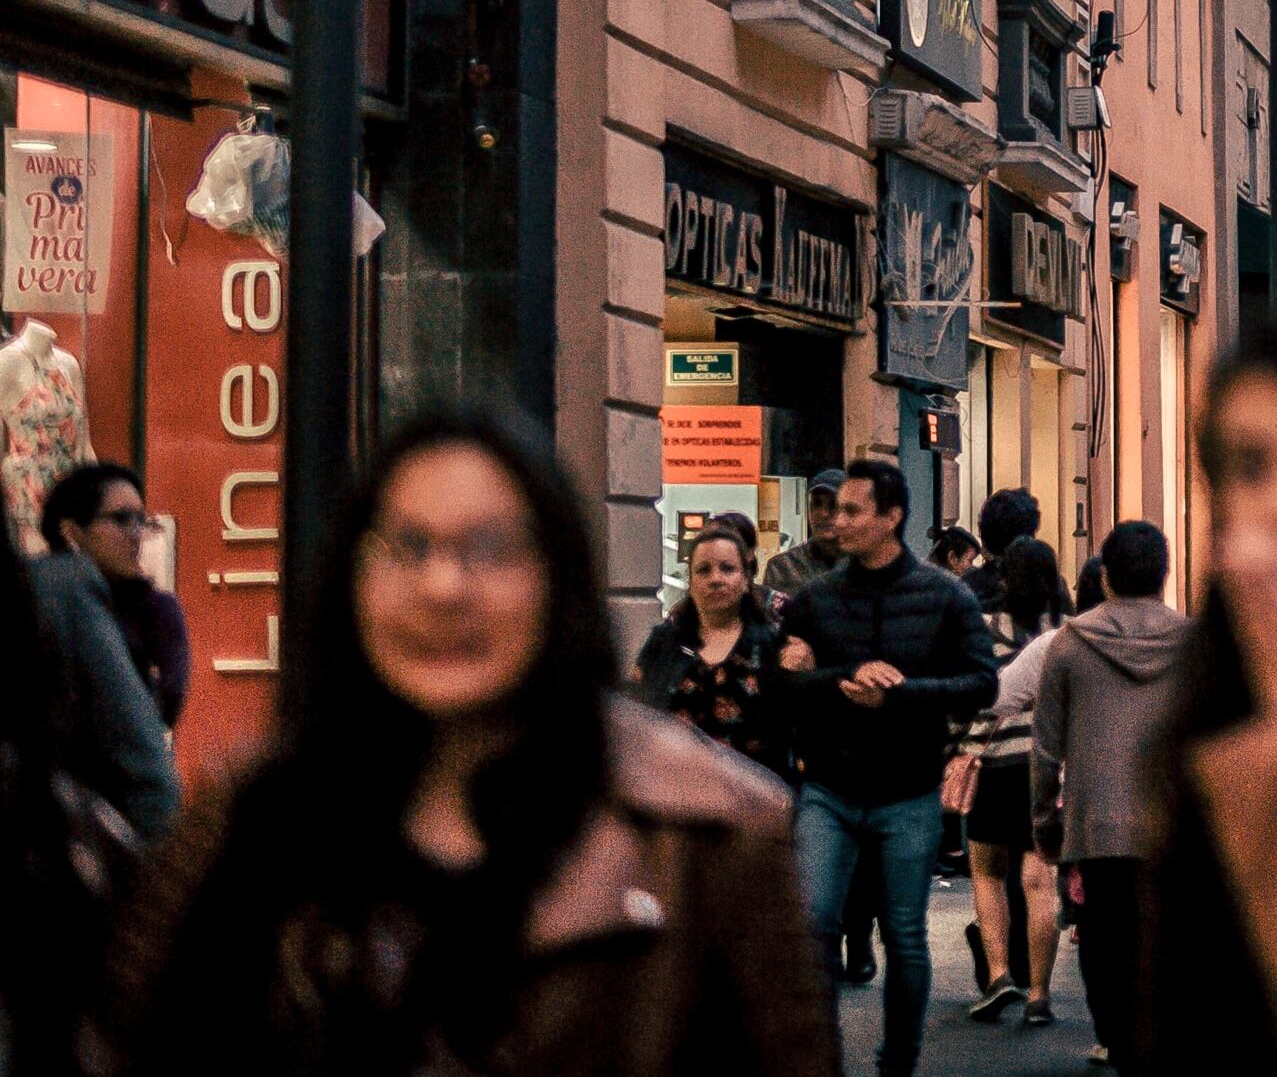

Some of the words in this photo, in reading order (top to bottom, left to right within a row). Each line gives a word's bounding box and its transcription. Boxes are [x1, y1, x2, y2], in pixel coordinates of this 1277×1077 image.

[25, 155, 97, 176] AVANCES
[29, 234, 85, 263] ma
[665, 182, 763, 295] OPTICAS
[17, 265, 98, 295] vera
[686, 355, 719, 363] SALIDA
[696, 364, 709, 372] DE
[207, 260, 281, 672] Linea
